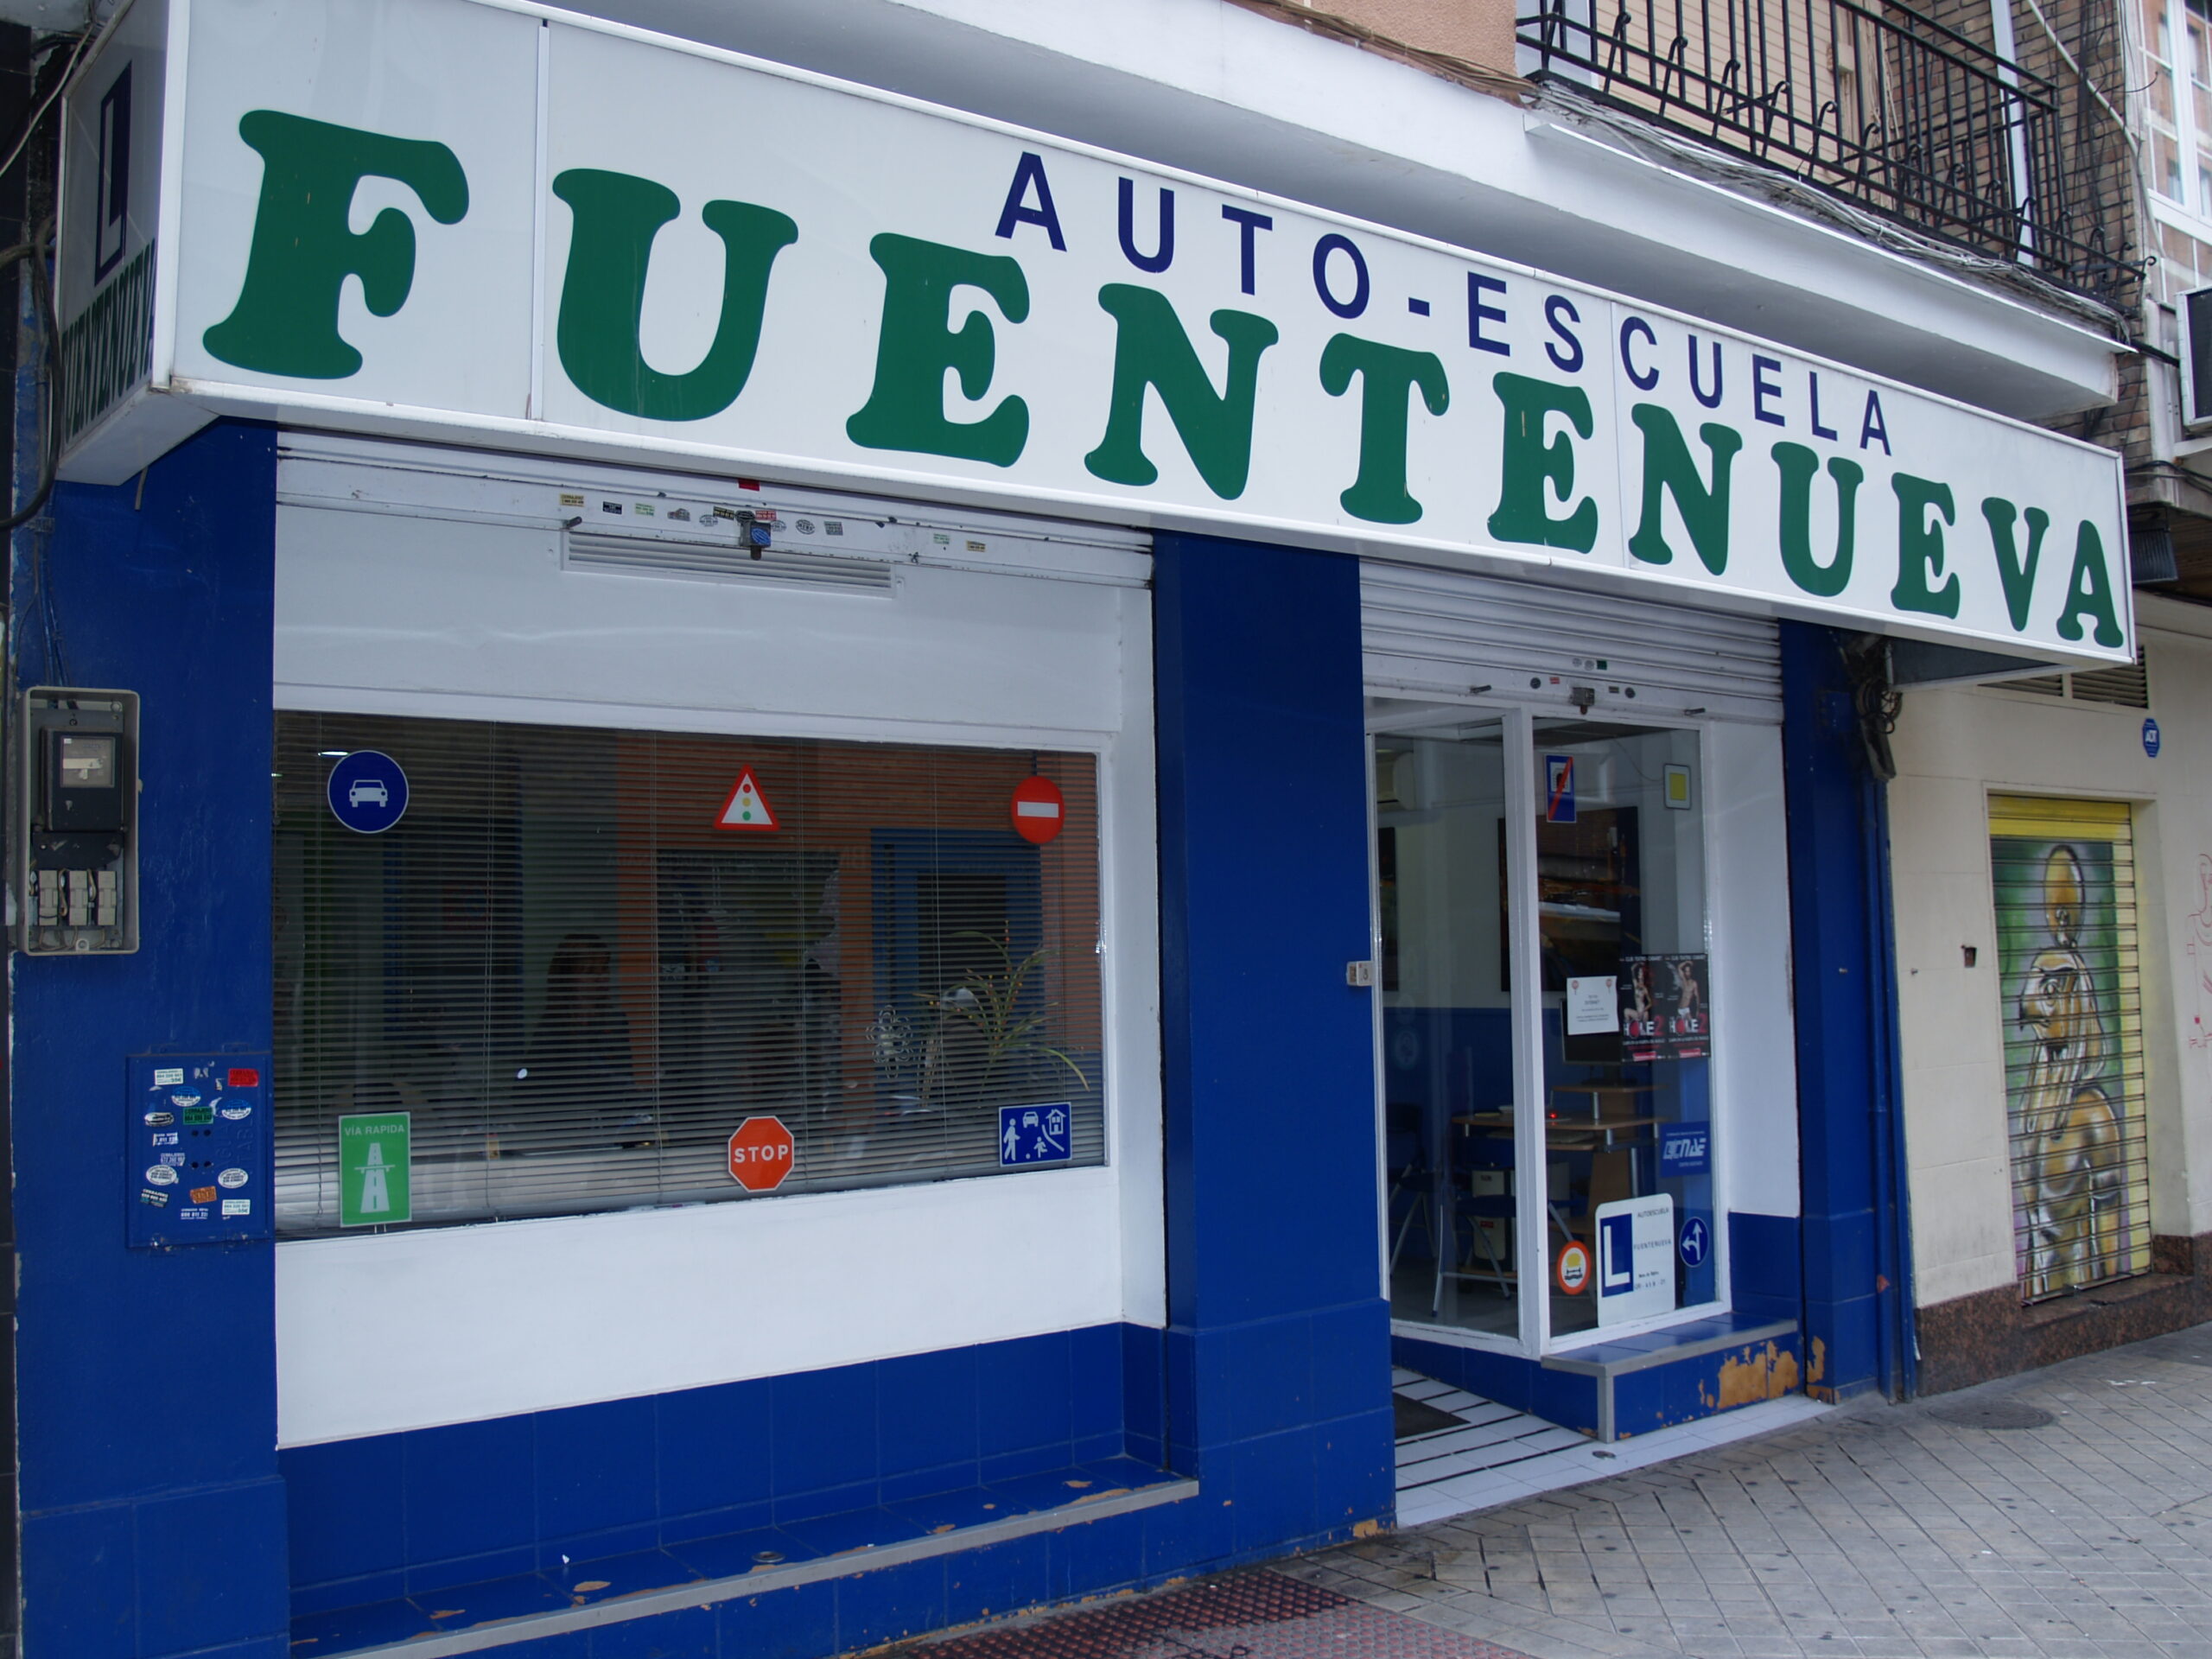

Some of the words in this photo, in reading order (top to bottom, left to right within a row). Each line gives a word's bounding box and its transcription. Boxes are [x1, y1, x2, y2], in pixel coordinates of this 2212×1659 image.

[201, 109, 2125, 648] FUENTENUEVA
[734, 1144, 789, 1163] STOP
[1637, 1207, 1669, 1218] AUTOESCUELA
[1633, 1239, 1672, 1250] FUENTENUEVA
[1605, 1225, 1630, 1287] L
